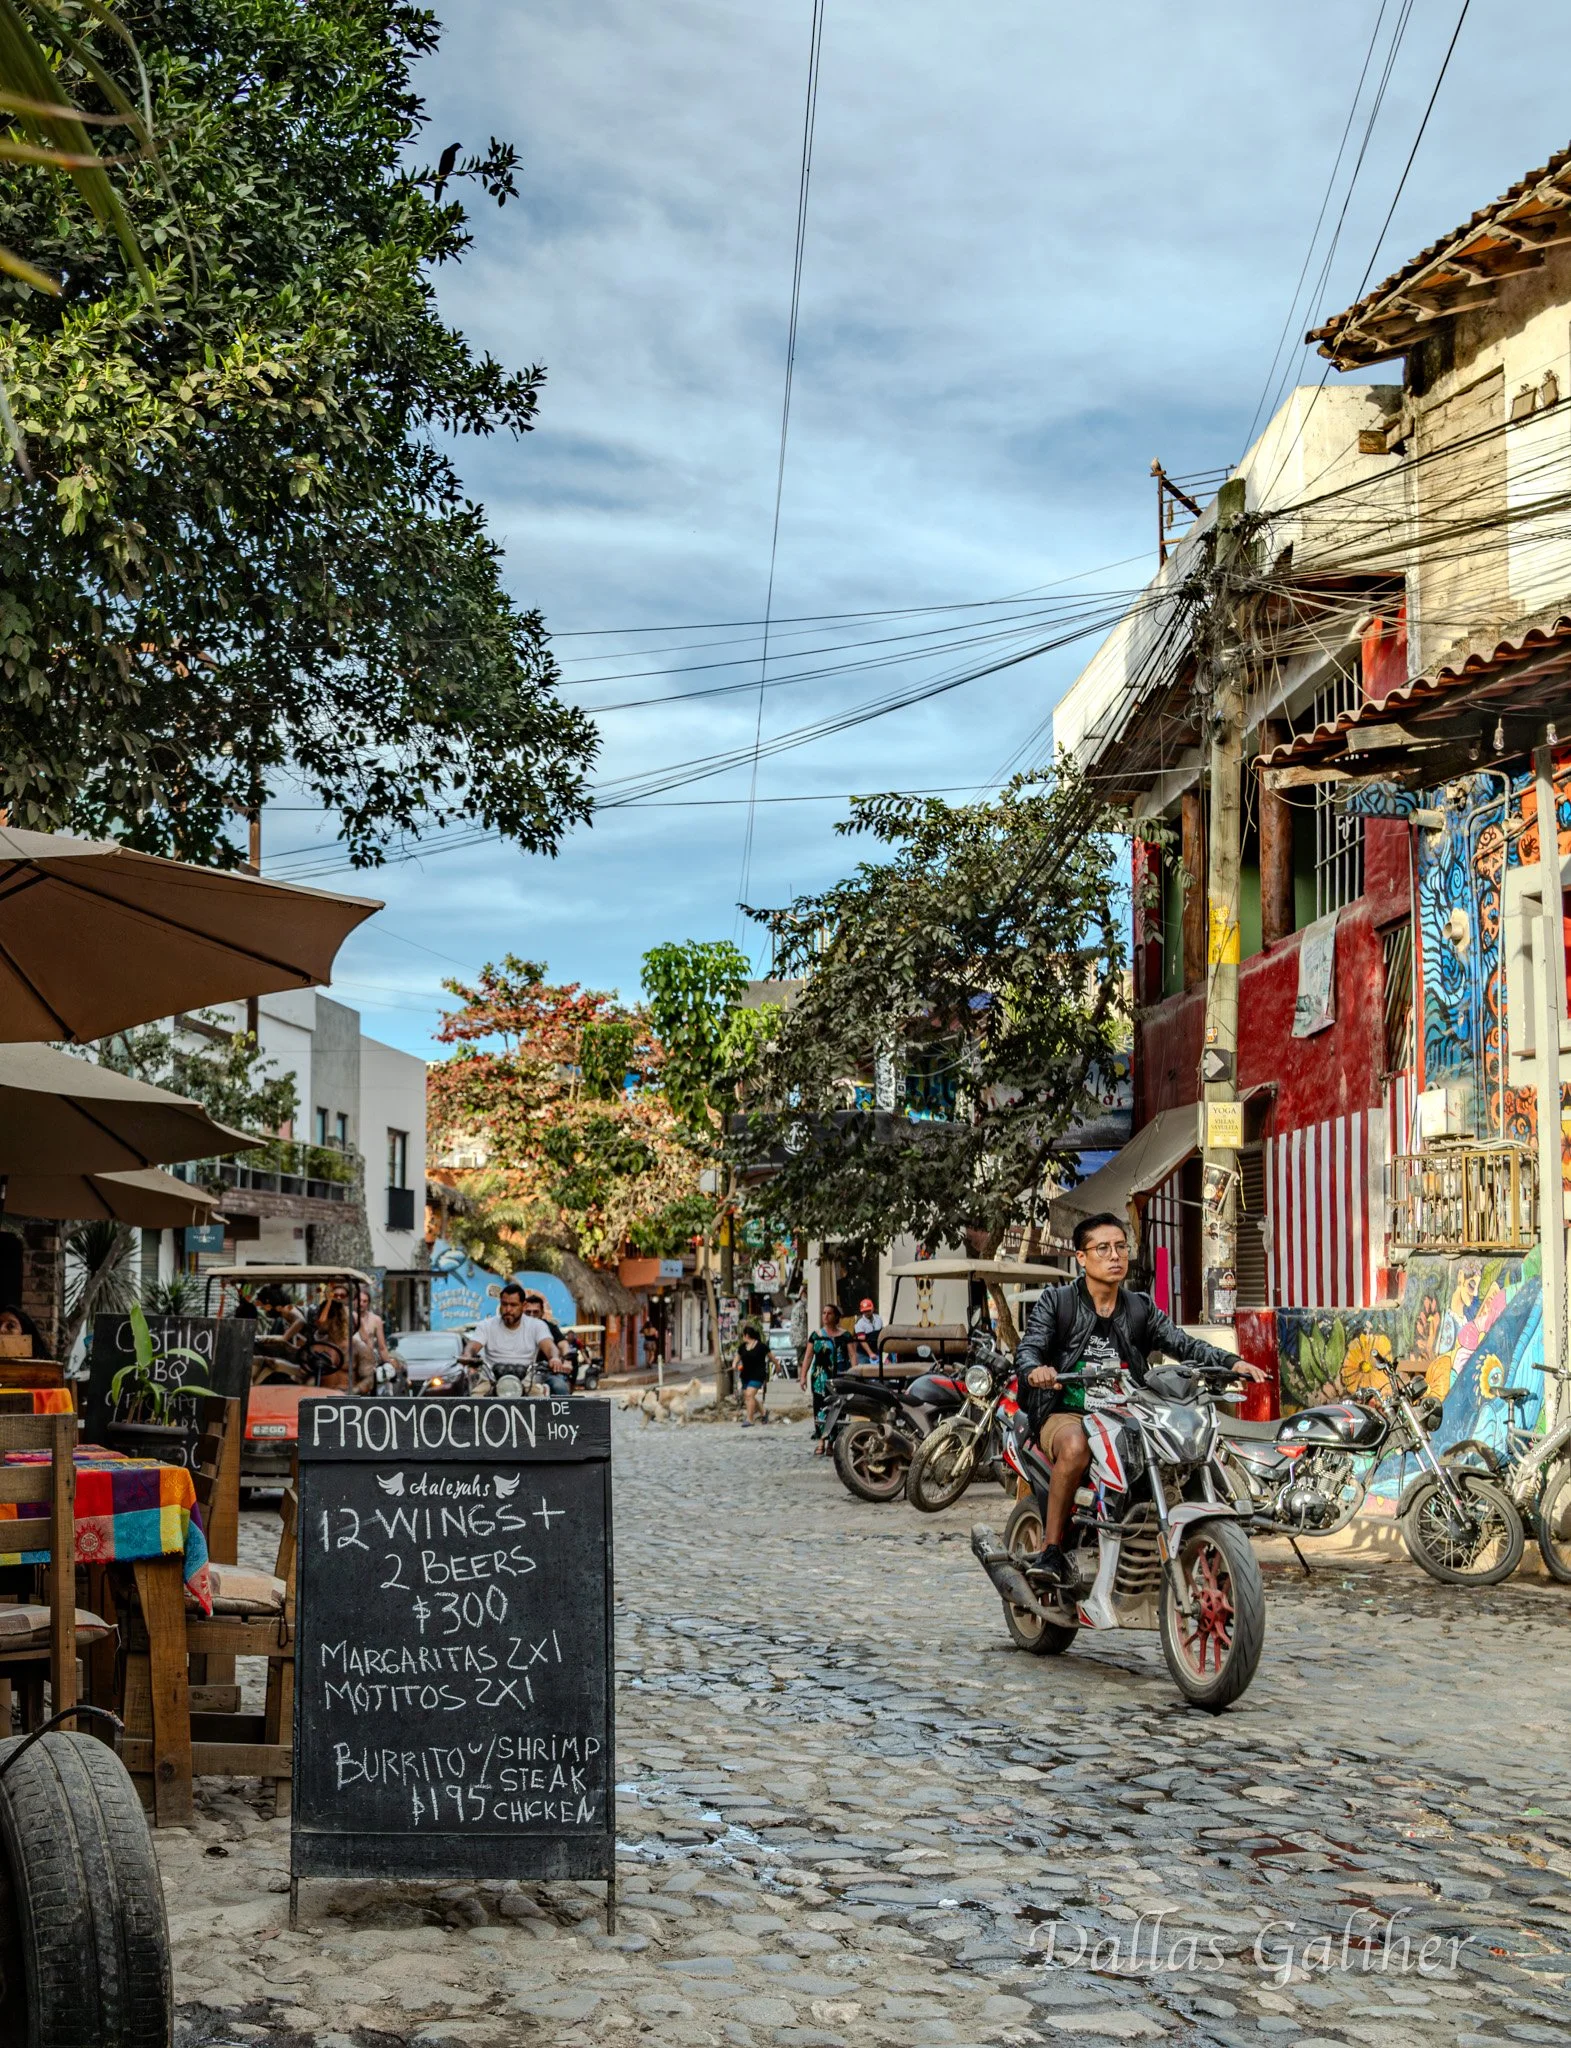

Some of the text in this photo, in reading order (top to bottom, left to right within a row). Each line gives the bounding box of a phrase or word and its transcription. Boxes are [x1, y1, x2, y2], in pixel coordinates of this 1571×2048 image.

[313, 1401, 571, 1451] PROMOCION DE
[321, 1496, 566, 1552] 12 WINGS +
[380, 1545, 536, 1590] 2 BEERS
[412, 1584, 508, 1634] $300
[321, 1640, 498, 1677] MARGARITAS
[324, 1680, 466, 1715] MOJITOS
[333, 1742, 466, 1791] BURRITO
[500, 1764, 587, 1794] STEAK
[412, 1783, 595, 1826] $195 CHICKEN
